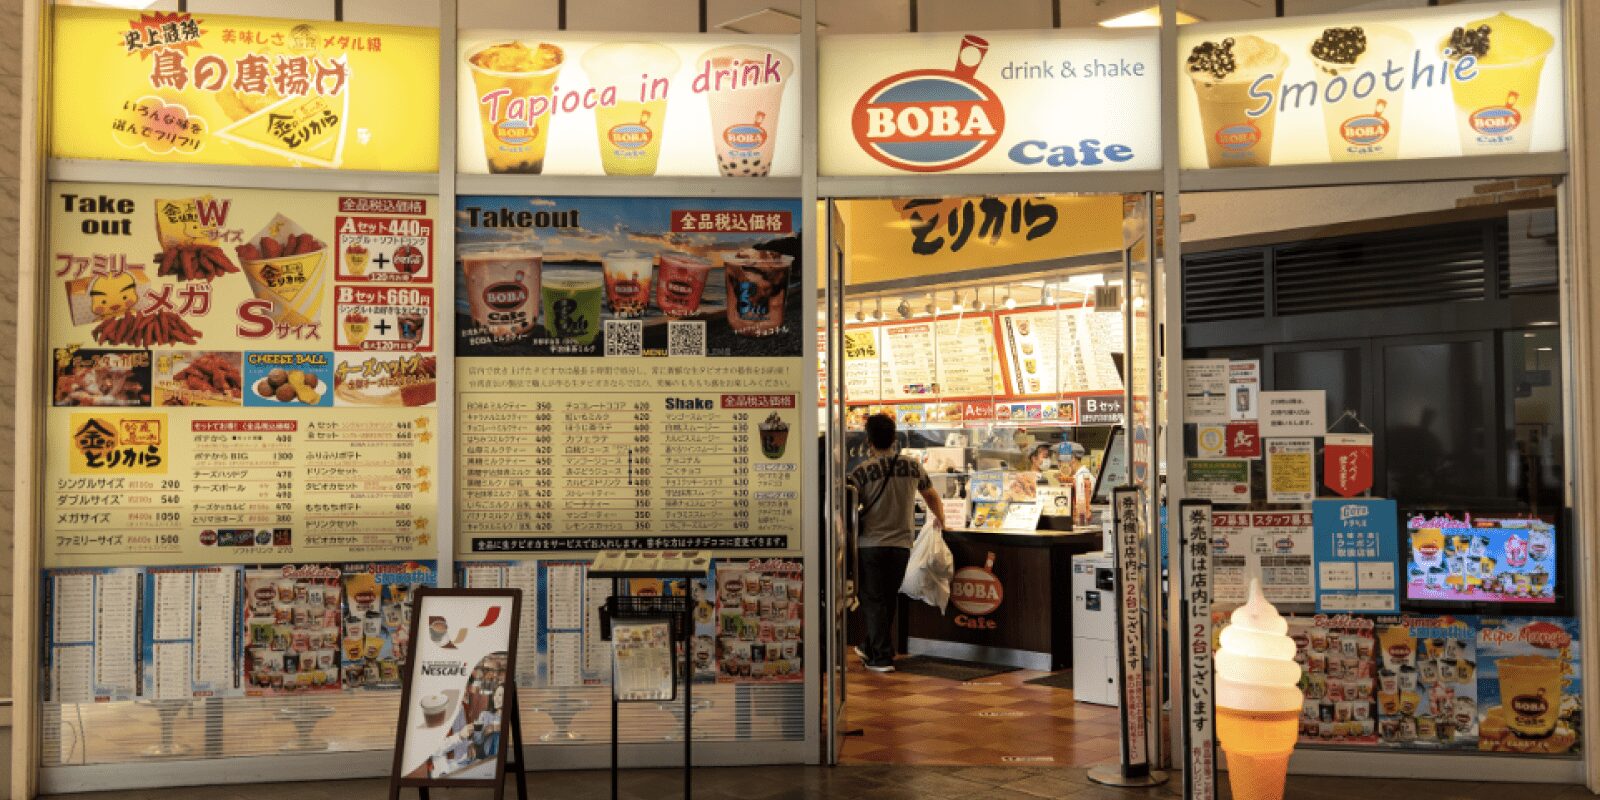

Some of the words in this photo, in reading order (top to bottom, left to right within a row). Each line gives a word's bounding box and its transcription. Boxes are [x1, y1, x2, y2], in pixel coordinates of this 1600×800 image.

[221, 29, 285, 45] 美味しさ
[323, 36, 382, 52] メダル級
[1001, 61, 1054, 81] drink
[1061, 62, 1077, 79] &
[1083, 59, 1145, 79] shake
[482, 86, 616, 127] Tapioca
[640, 74, 669, 103] in
[692, 53, 780, 93] drink
[1246, 49, 1477, 117] Smoothie
[123, 101, 202, 134] いろんな味を
[866, 105, 996, 138] BOBA
[112, 119, 201, 150] 選んでフリフリ
[1008, 139, 1135, 167] Cafe
[60, 193, 136, 214] Take
[195, 199, 231, 227] W
[342, 198, 422, 214] 全品税込価格
[81, 218, 133, 236] out
[466, 207, 580, 229] Takeout
[680, 212, 784, 231] 全品税込価格
[904, 197, 1059, 255] とりから
[207, 228, 244, 243] サイズ
[55, 253, 146, 278] ファミリー
[142, 284, 211, 316] メガ
[487, 293, 526, 304] BOBA
[236, 299, 275, 339] S
[275, 322, 322, 340] サイズ
[247, 353, 294, 366] CHEESE
[297, 353, 328, 366] BALL
[665, 397, 713, 411] Shake
[724, 396, 791, 407] 全品税込価格
[74, 418, 162, 468] 金のとりから
[57, 478, 125, 489] シングルサイズ
[58, 494, 124, 506] ダブルサイズ
[58, 512, 111, 524] メガサイズ
[1255, 514, 1313, 527] スタッフ募集
[56, 535, 124, 547] ファミリーサイズ
[953, 580, 999, 601] BOBA
[954, 615, 998, 630] Cafe
[1482, 628, 1514, 646] Ripe
